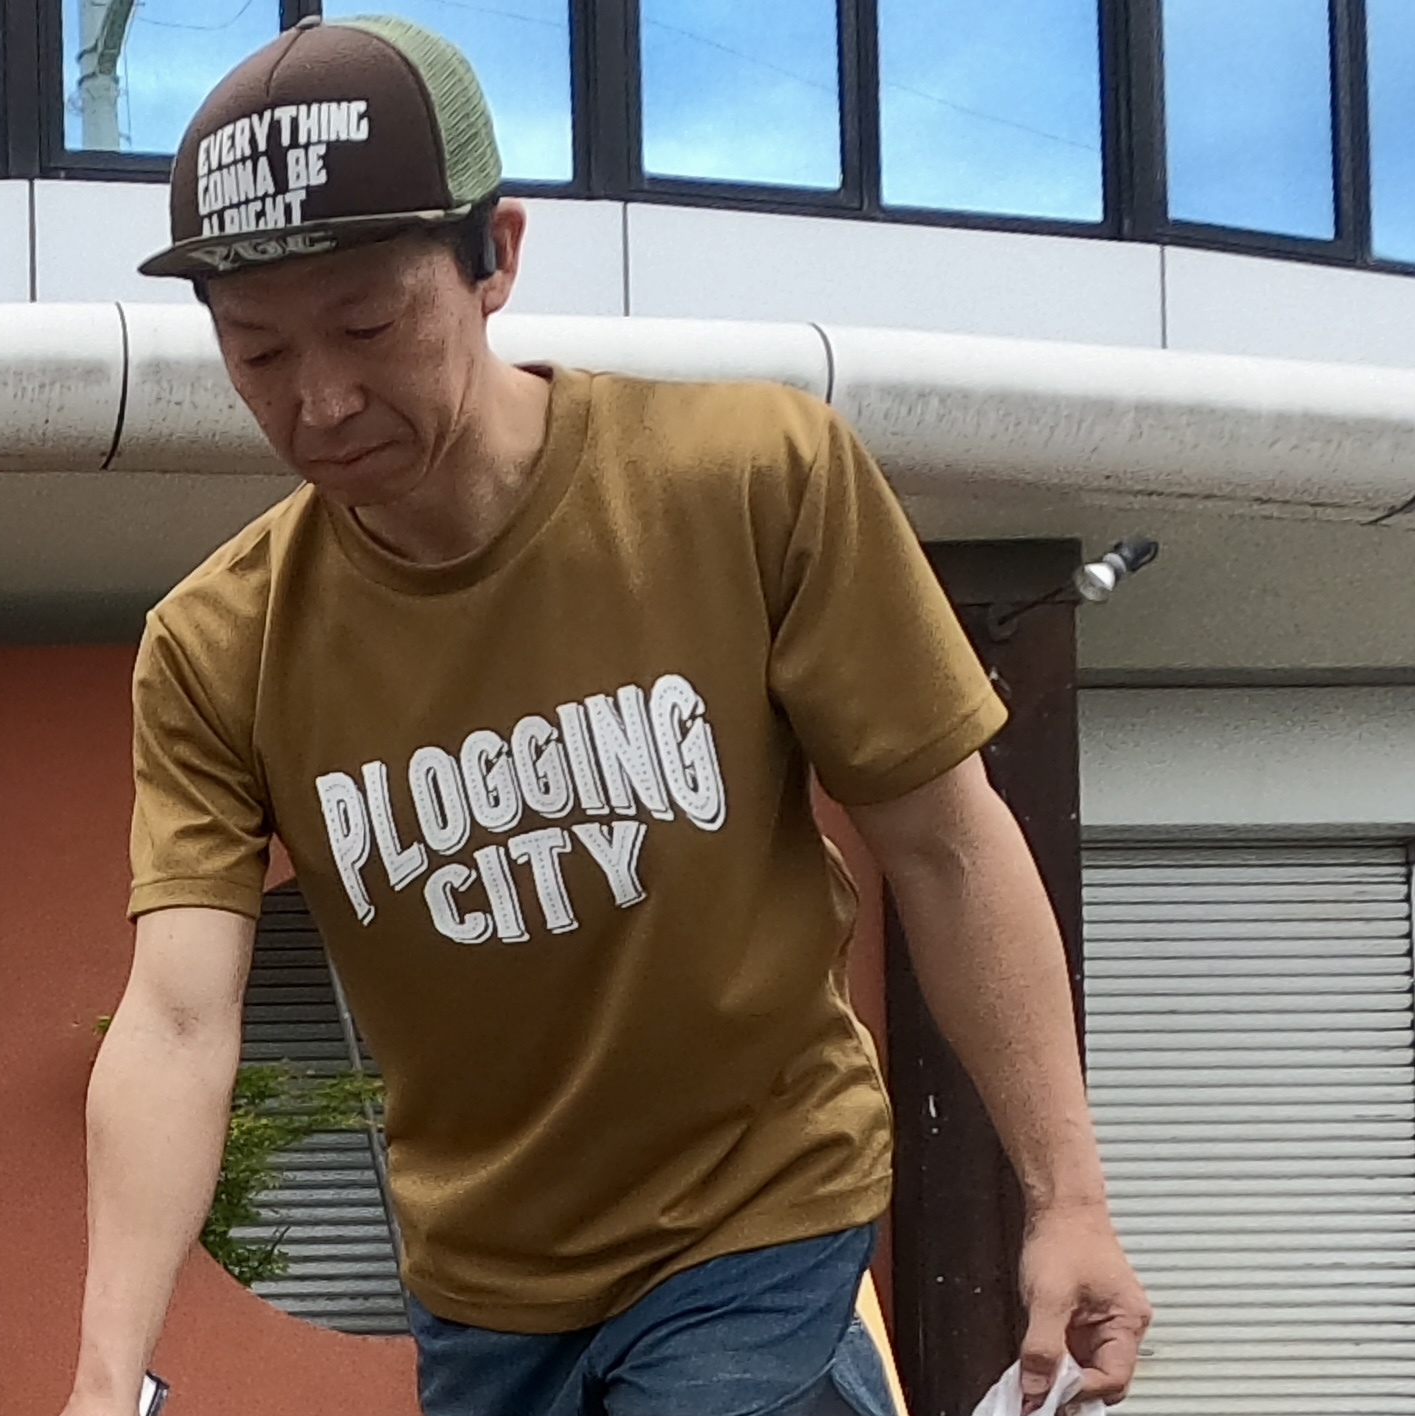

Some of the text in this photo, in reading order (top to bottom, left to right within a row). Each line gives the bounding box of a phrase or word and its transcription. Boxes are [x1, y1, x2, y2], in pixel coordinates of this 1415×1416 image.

[197, 100, 370, 177] EVERYTHING
[197, 143, 328, 217] GONNA BE
[315, 674, 727, 926] PLOGGING
[423, 821, 647, 944] CITY
